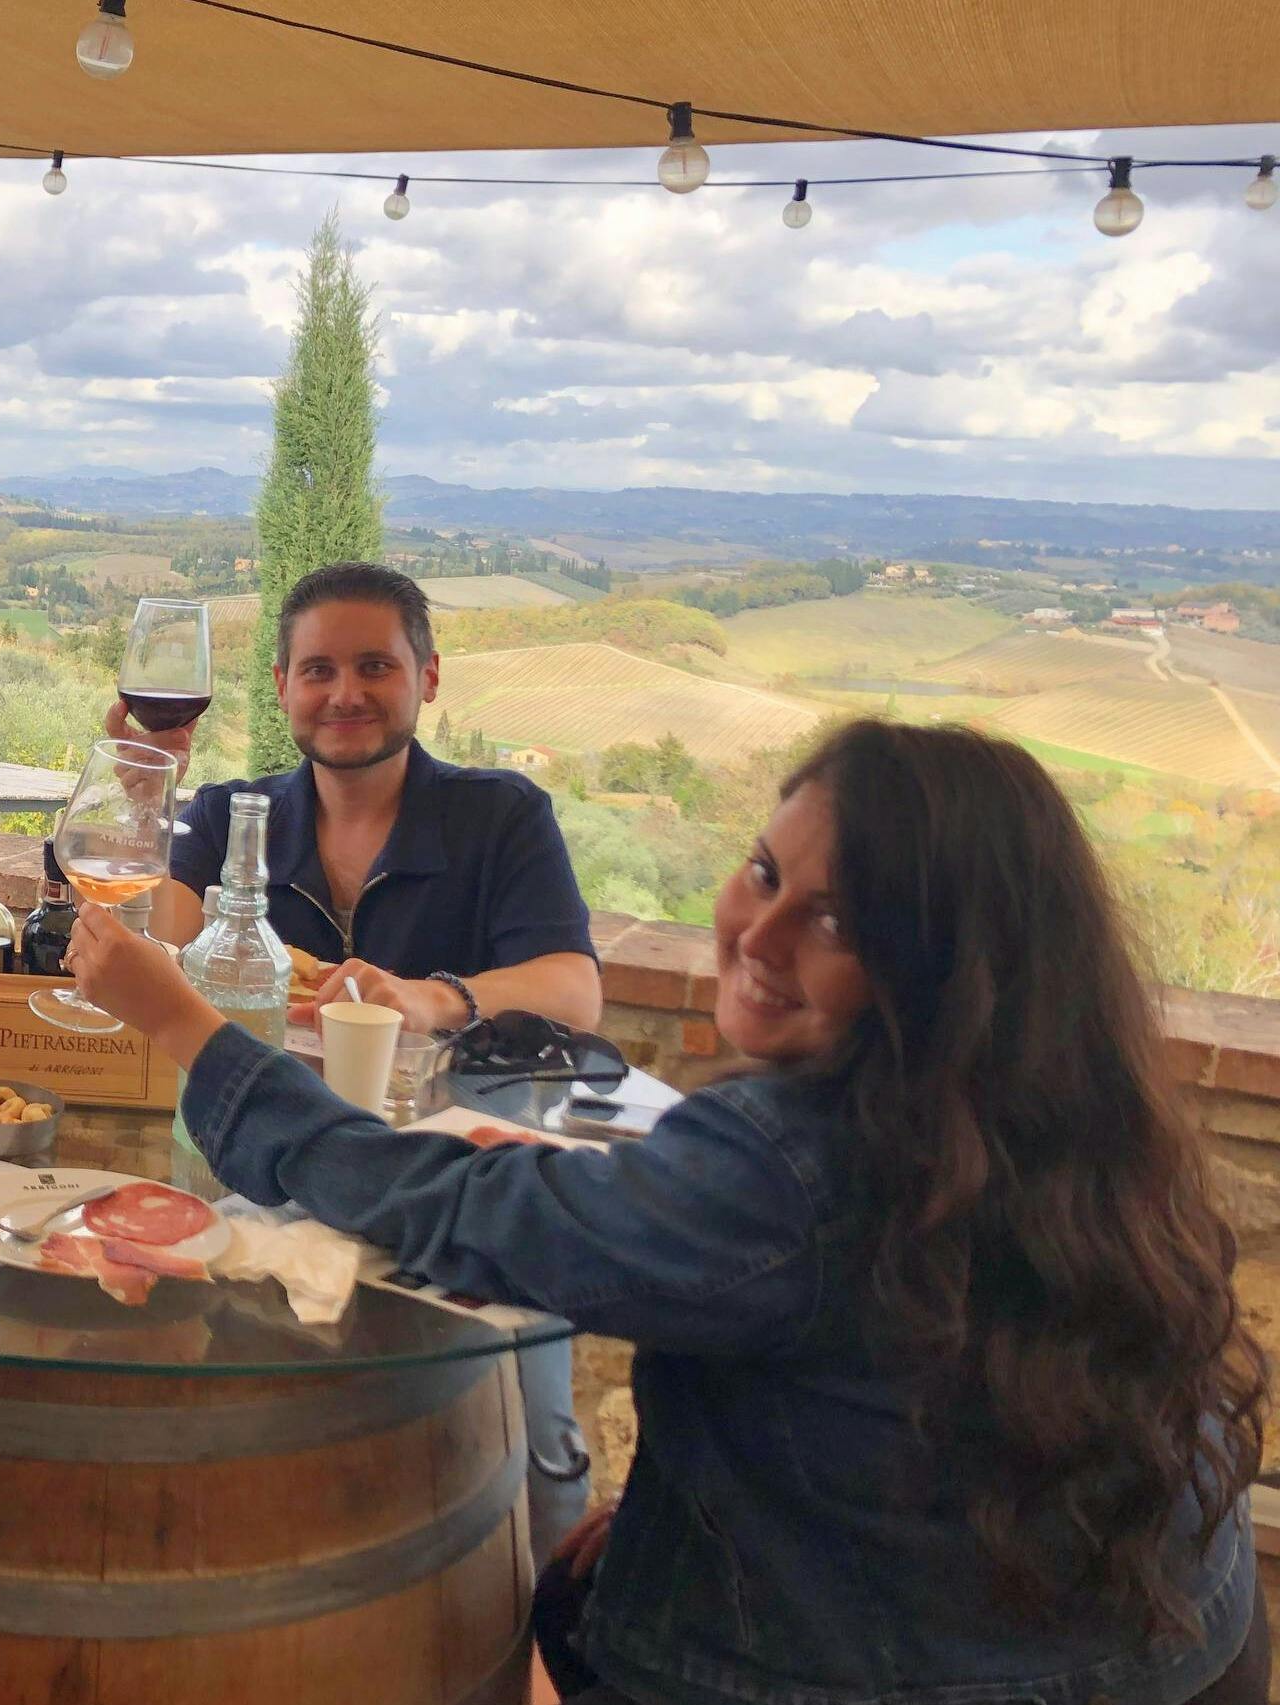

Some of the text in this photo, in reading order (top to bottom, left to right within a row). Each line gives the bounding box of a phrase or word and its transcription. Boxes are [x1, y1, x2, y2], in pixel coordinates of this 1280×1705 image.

[99, 833, 155, 849] ARRIGONI
[45, 1063, 104, 1076] ARRIGONI
[22, 1183, 81, 1192] ARRIGONI
